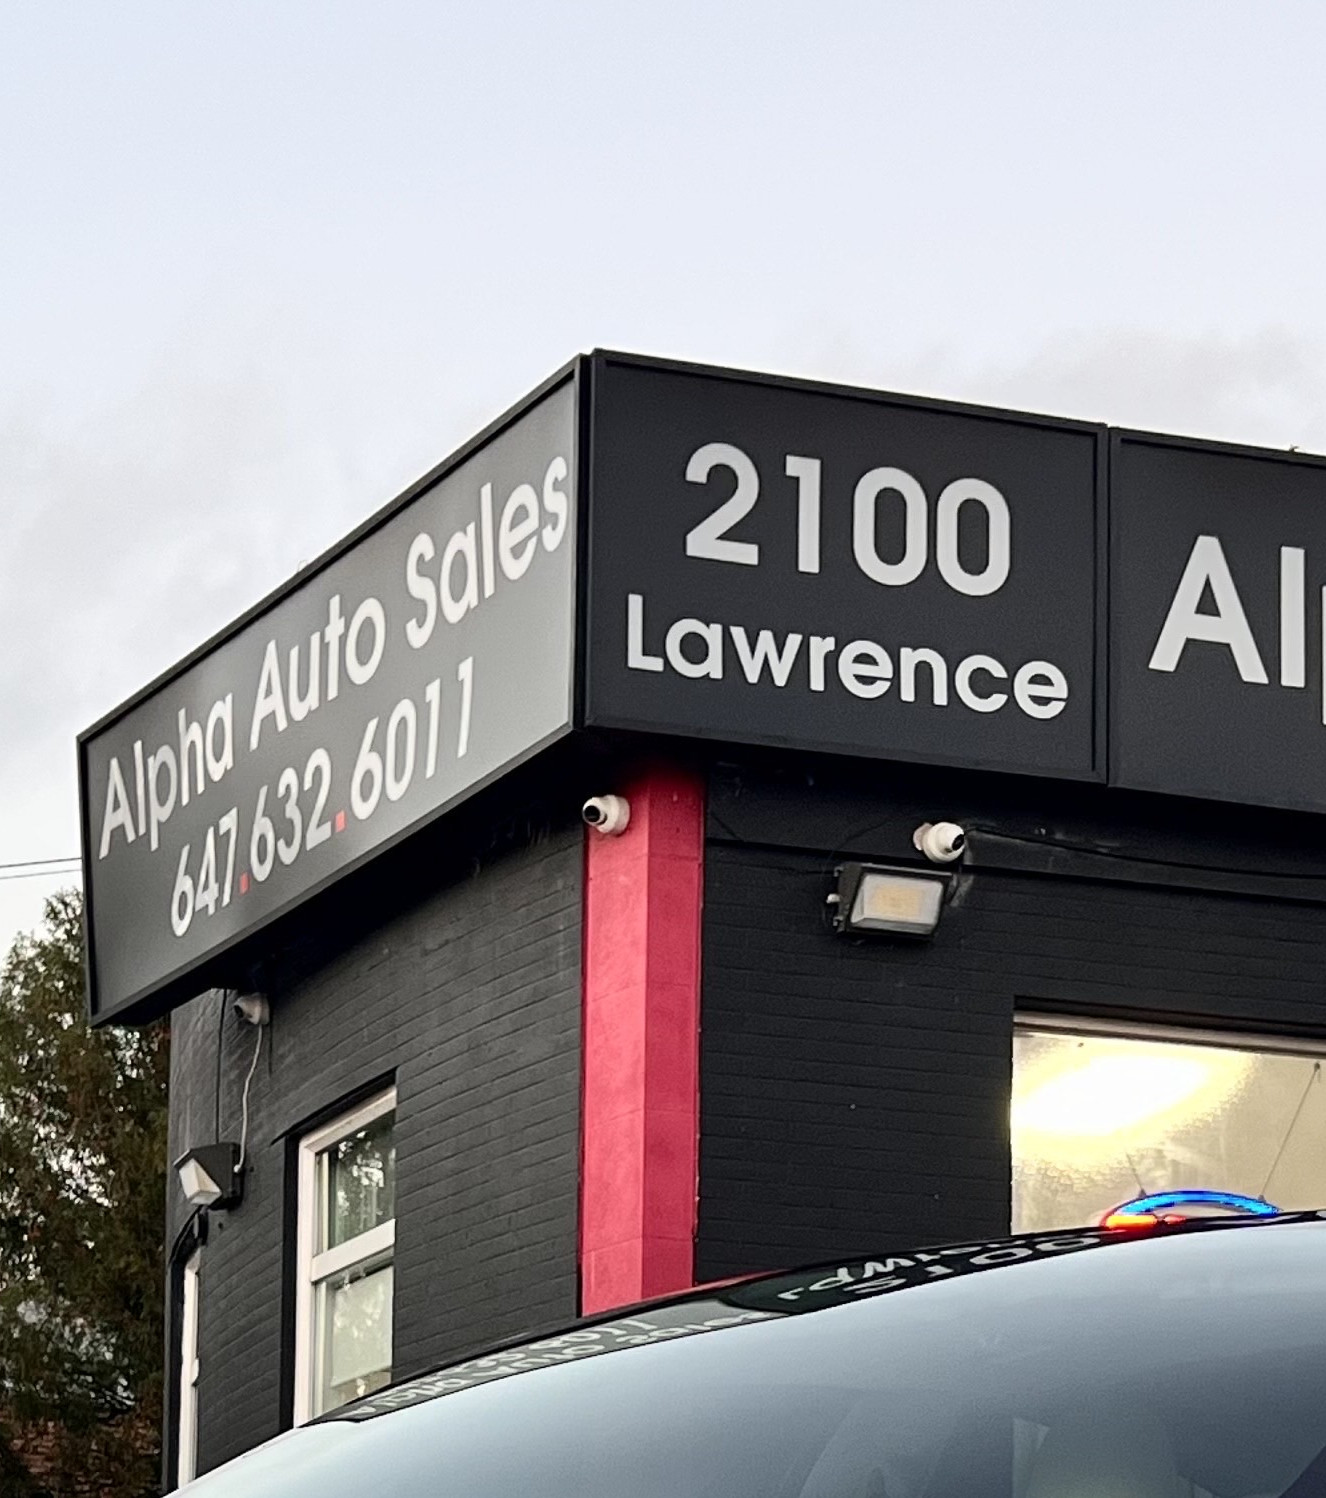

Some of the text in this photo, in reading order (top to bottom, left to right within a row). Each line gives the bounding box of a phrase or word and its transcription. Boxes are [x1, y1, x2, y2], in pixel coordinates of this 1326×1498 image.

[684, 441, 1012, 597] 2100
[99, 455, 570, 860] Alpha Auto Sales
[627, 592, 1069, 720] Lawrence
[170, 655, 474, 938] 647.632.6011
